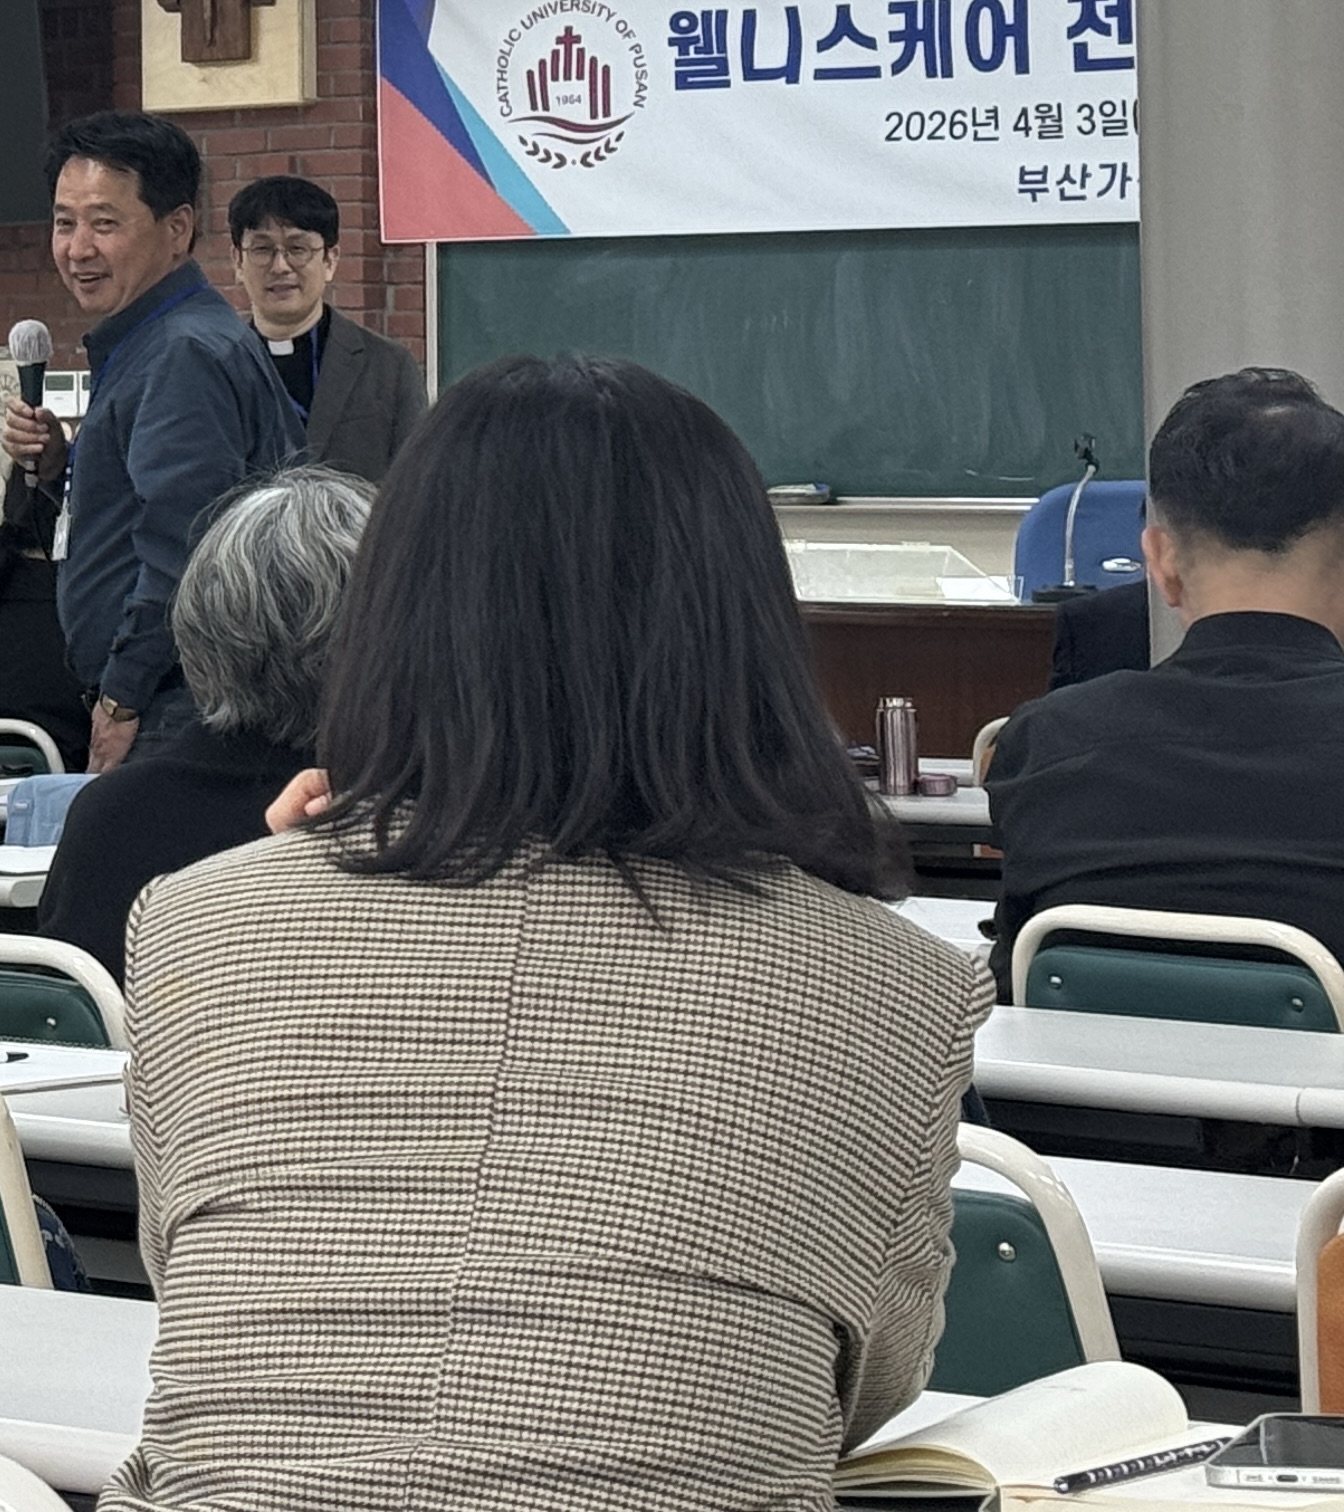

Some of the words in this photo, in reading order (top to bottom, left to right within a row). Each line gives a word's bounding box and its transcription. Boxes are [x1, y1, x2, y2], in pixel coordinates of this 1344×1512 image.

[496, 28, 522, 118] CATHOLIC
[615, 19, 637, 40] OF
[628, 43, 649, 109] PUSAN
[884, 105, 1000, 142] 2026년
[1012, 102, 1064, 140] 4월
[1017, 162, 1138, 202] 부산가
